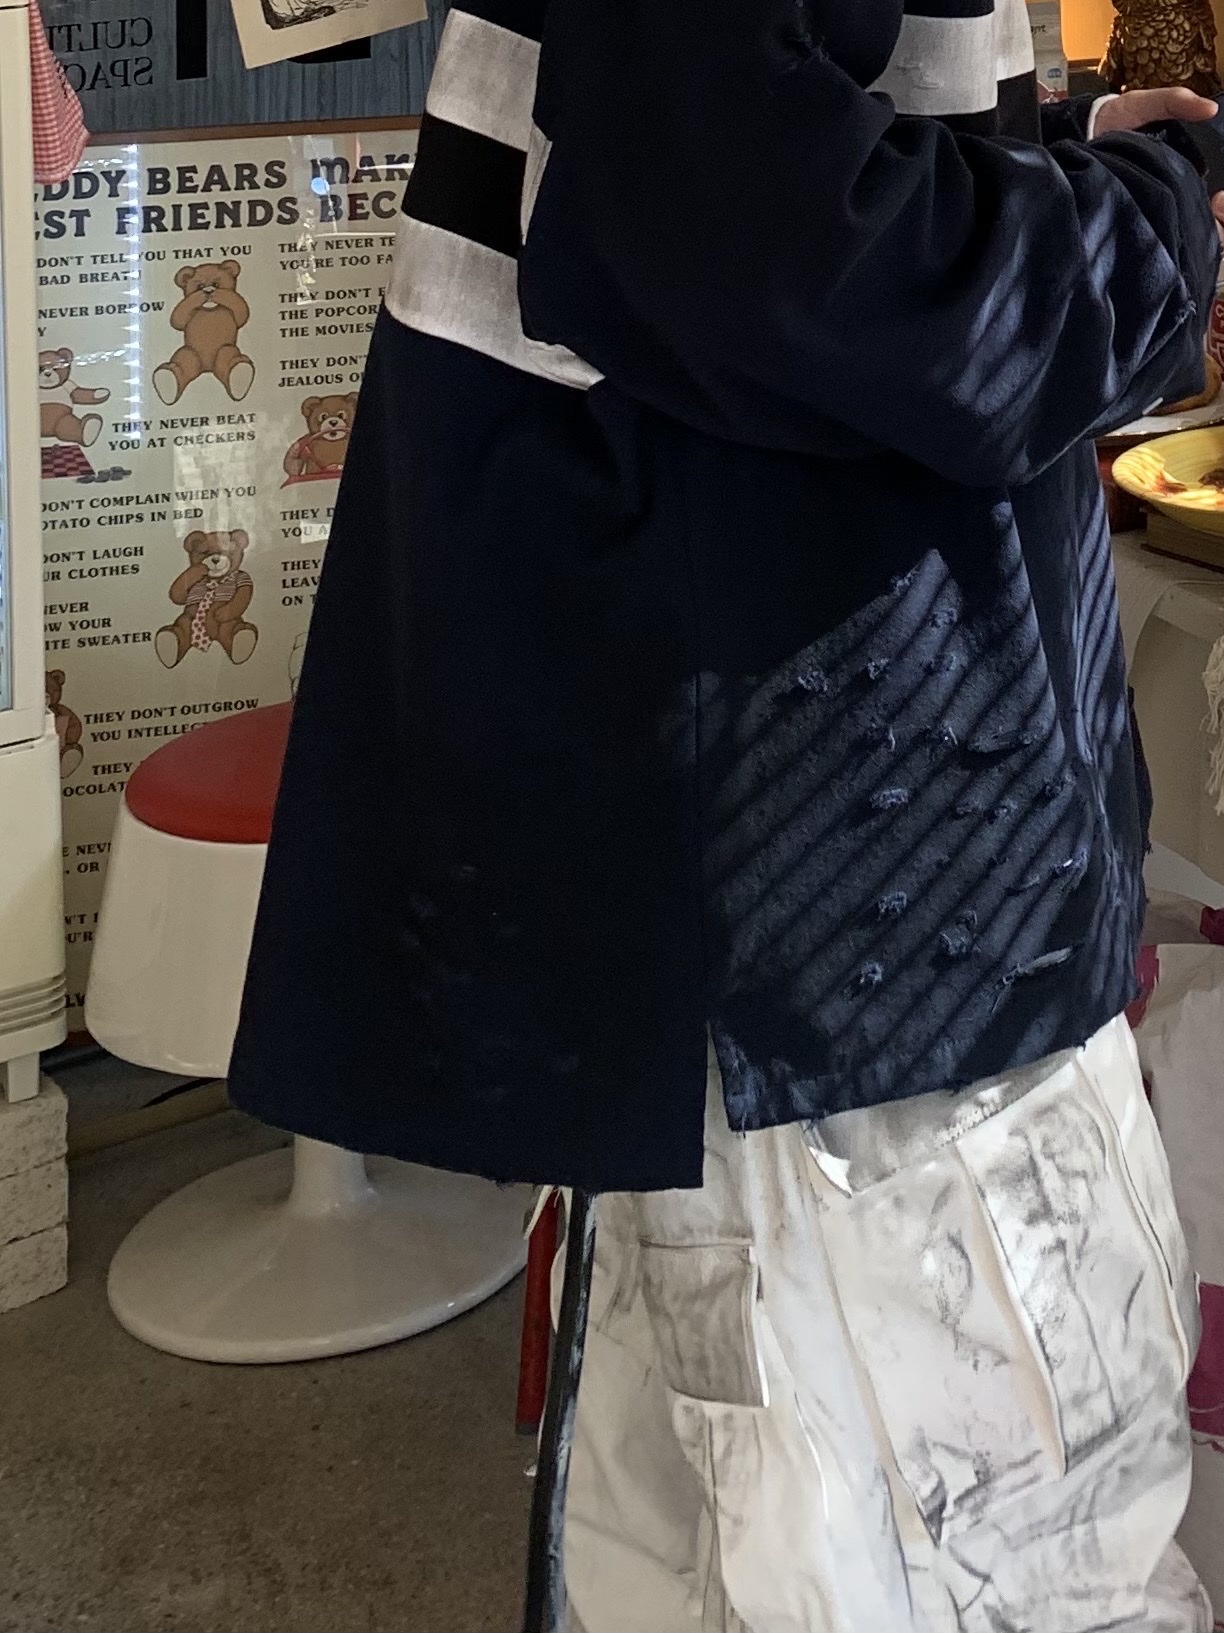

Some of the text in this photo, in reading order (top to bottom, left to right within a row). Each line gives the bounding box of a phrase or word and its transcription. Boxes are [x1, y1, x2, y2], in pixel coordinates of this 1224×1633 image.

[34, 153, 411, 204] DDY BEARS MAK
[34, 190, 397, 242] ST FRIENDS BEC
[325, 237, 375, 251] NEVER
[379, 236, 396, 247] TE
[91, 252, 127, 265] TELL
[172, 247, 213, 260] THAT
[219, 245, 253, 256] YOU
[339, 255, 370, 267] TOO
[376, 253, 394, 265] FA
[39, 274, 71, 287] BAD
[325, 287, 372, 301] DON'T
[37, 305, 90, 320] NEVER
[278, 304, 378, 321] THE POPCOR
[279, 322, 375, 339] THE MOVIES
[279, 354, 368, 371] THEY DON'
[278, 371, 365, 388] JEALOUS O
[112, 412, 257, 434] THEY NEVER BEAT
[108, 429, 257, 452] YOU AT CHECKERS
[89, 491, 172, 509] COMPLAIN
[174, 488, 220, 502] WHEN
[224, 485, 258, 498] YOU
[97, 511, 145, 528] CHIPS
[150, 510, 168, 522] IN
[172, 507, 204, 521] BED
[280, 508, 320, 521] THEY
[281, 526, 313, 538] YOU
[92, 545, 145, 561] LAUGH
[67, 563, 141, 581] CLOTHES
[281, 559, 322, 572] THEY
[281, 575, 321, 589] LEAV
[281, 595, 304, 607] ON
[69, 617, 113, 632] YOUR
[44, 631, 153, 652] ITE SWEATER
[83, 697, 260, 726] THEY DON'T OUTGROW
[90, 729, 122, 743] YOU
[92, 761, 134, 776] THEY
[63, 780, 126, 798] OCOLAT
